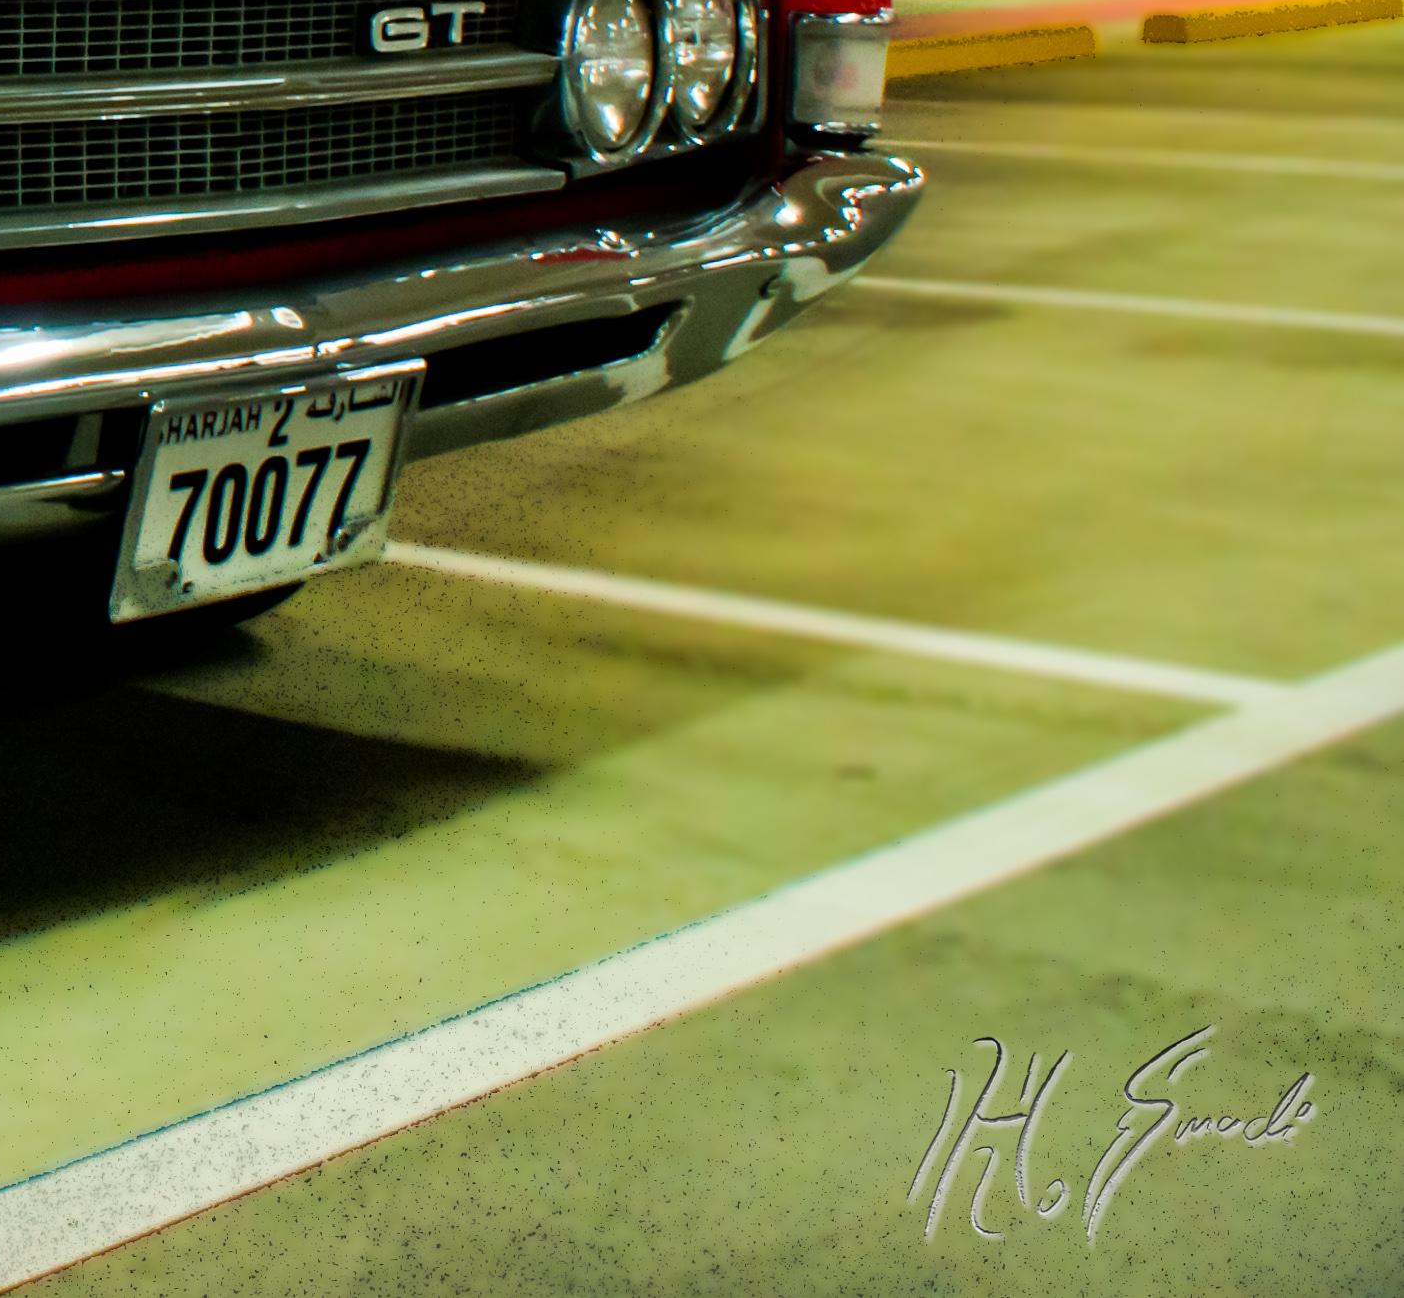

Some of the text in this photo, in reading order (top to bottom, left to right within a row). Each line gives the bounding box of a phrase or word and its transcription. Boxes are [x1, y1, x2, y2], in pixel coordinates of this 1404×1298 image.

[370, 1, 487, 53] GT
[159, 397, 295, 447] HARJAH 2
[167, 438, 372, 566] 70077
